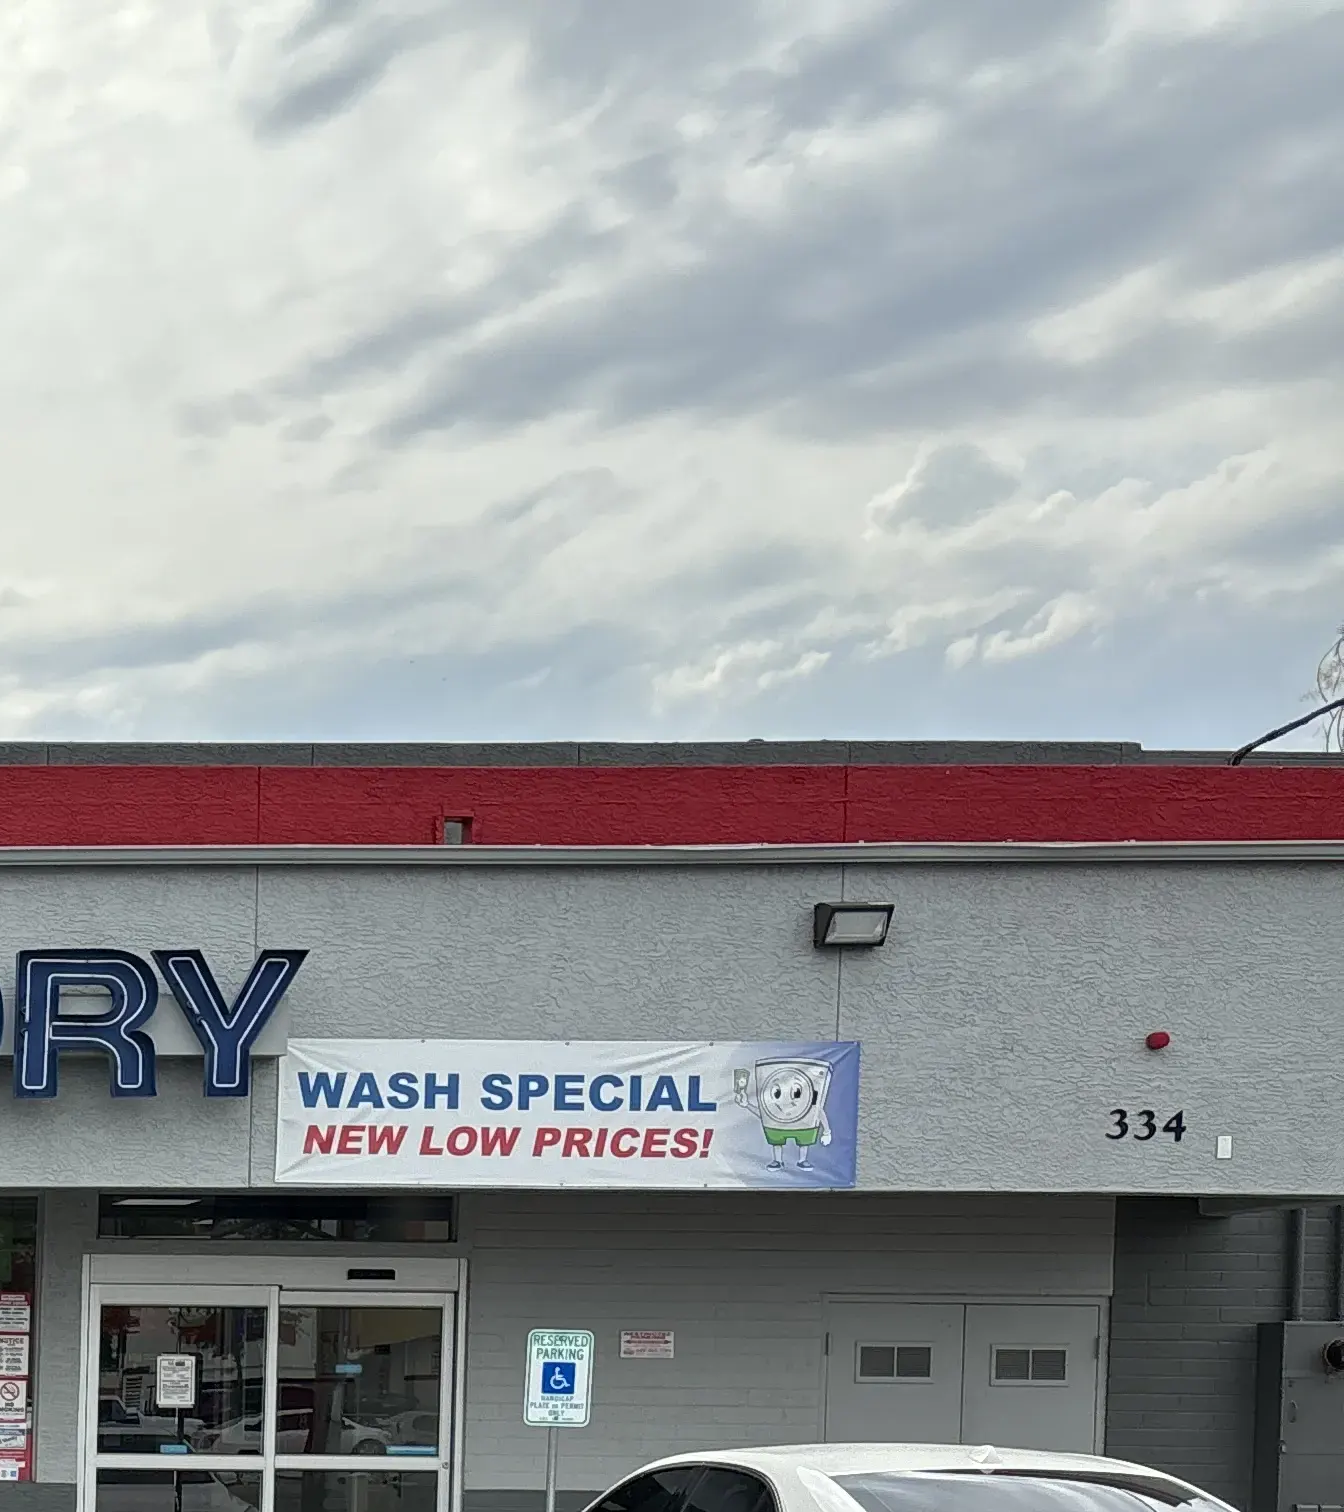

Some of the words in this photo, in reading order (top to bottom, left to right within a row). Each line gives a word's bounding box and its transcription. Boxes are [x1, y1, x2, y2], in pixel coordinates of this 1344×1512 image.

[297, 1071, 460, 1110] WASH
[481, 1073, 717, 1112] SPECIAL
[302, 1124, 408, 1156] NEW
[418, 1126, 522, 1157] LOW
[532, 1128, 714, 1158] PRICES!
[1105, 1108, 1187, 1142] 334
[533, 1334, 589, 1347] RESERVED
[536, 1349, 585, 1361] PARKING
